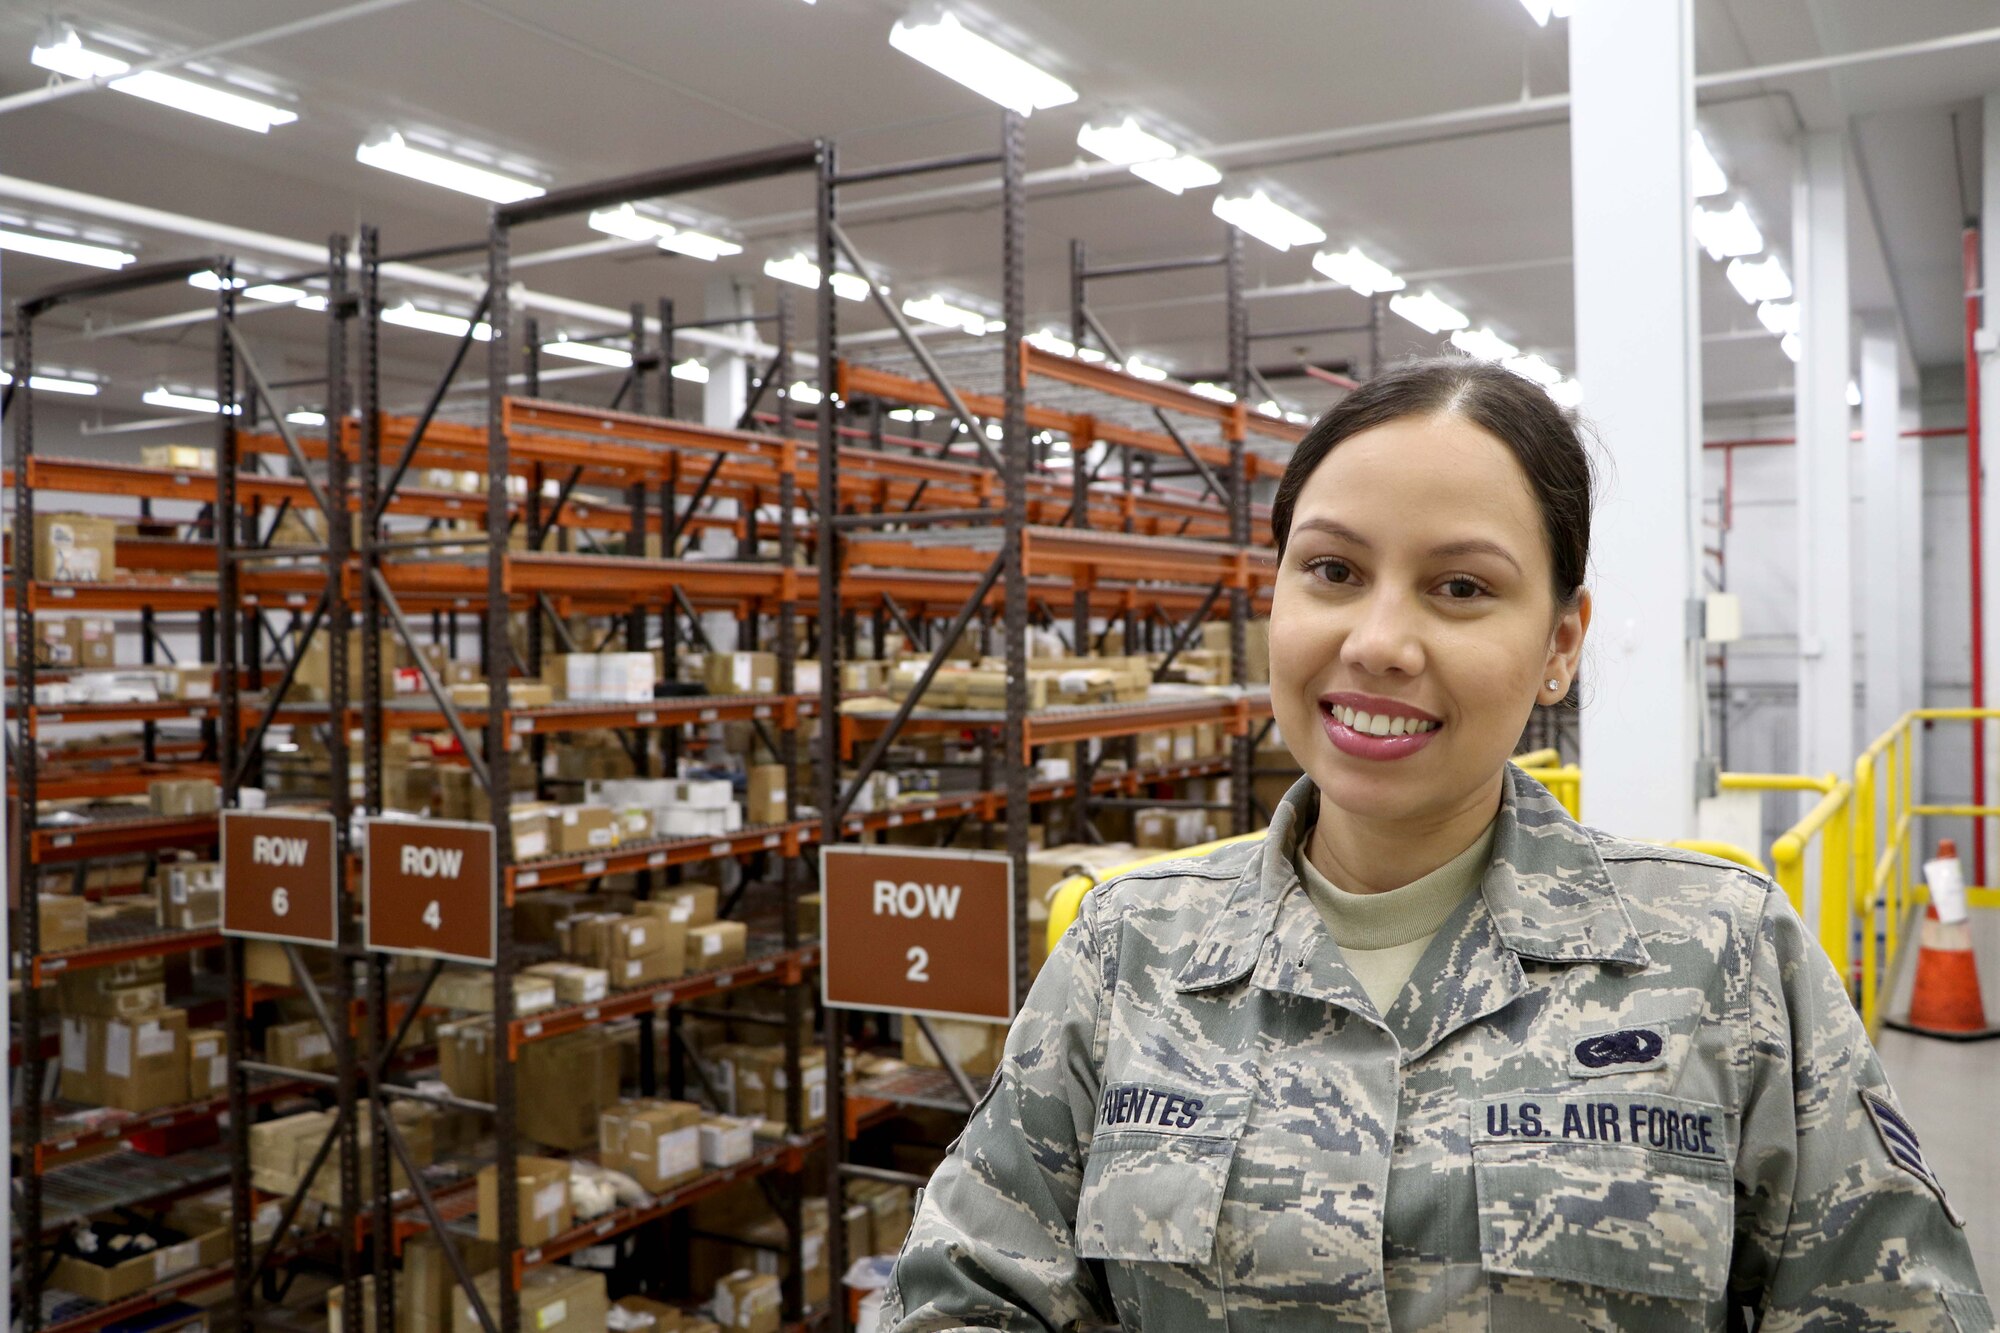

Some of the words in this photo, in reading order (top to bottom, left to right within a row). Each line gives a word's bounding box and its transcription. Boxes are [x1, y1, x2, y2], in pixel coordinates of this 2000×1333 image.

[253, 836, 307, 867] ROW
[401, 845, 463, 878] ROW
[271, 887, 289, 916] 6
[422, 900, 441, 930] 4
[873, 880, 962, 920] ROW
[906, 946, 929, 982] 2
[1487, 1102, 1551, 1137] U.S.
[1562, 1103, 1621, 1142] AIR
[1629, 1104, 1715, 1154] FORCE
